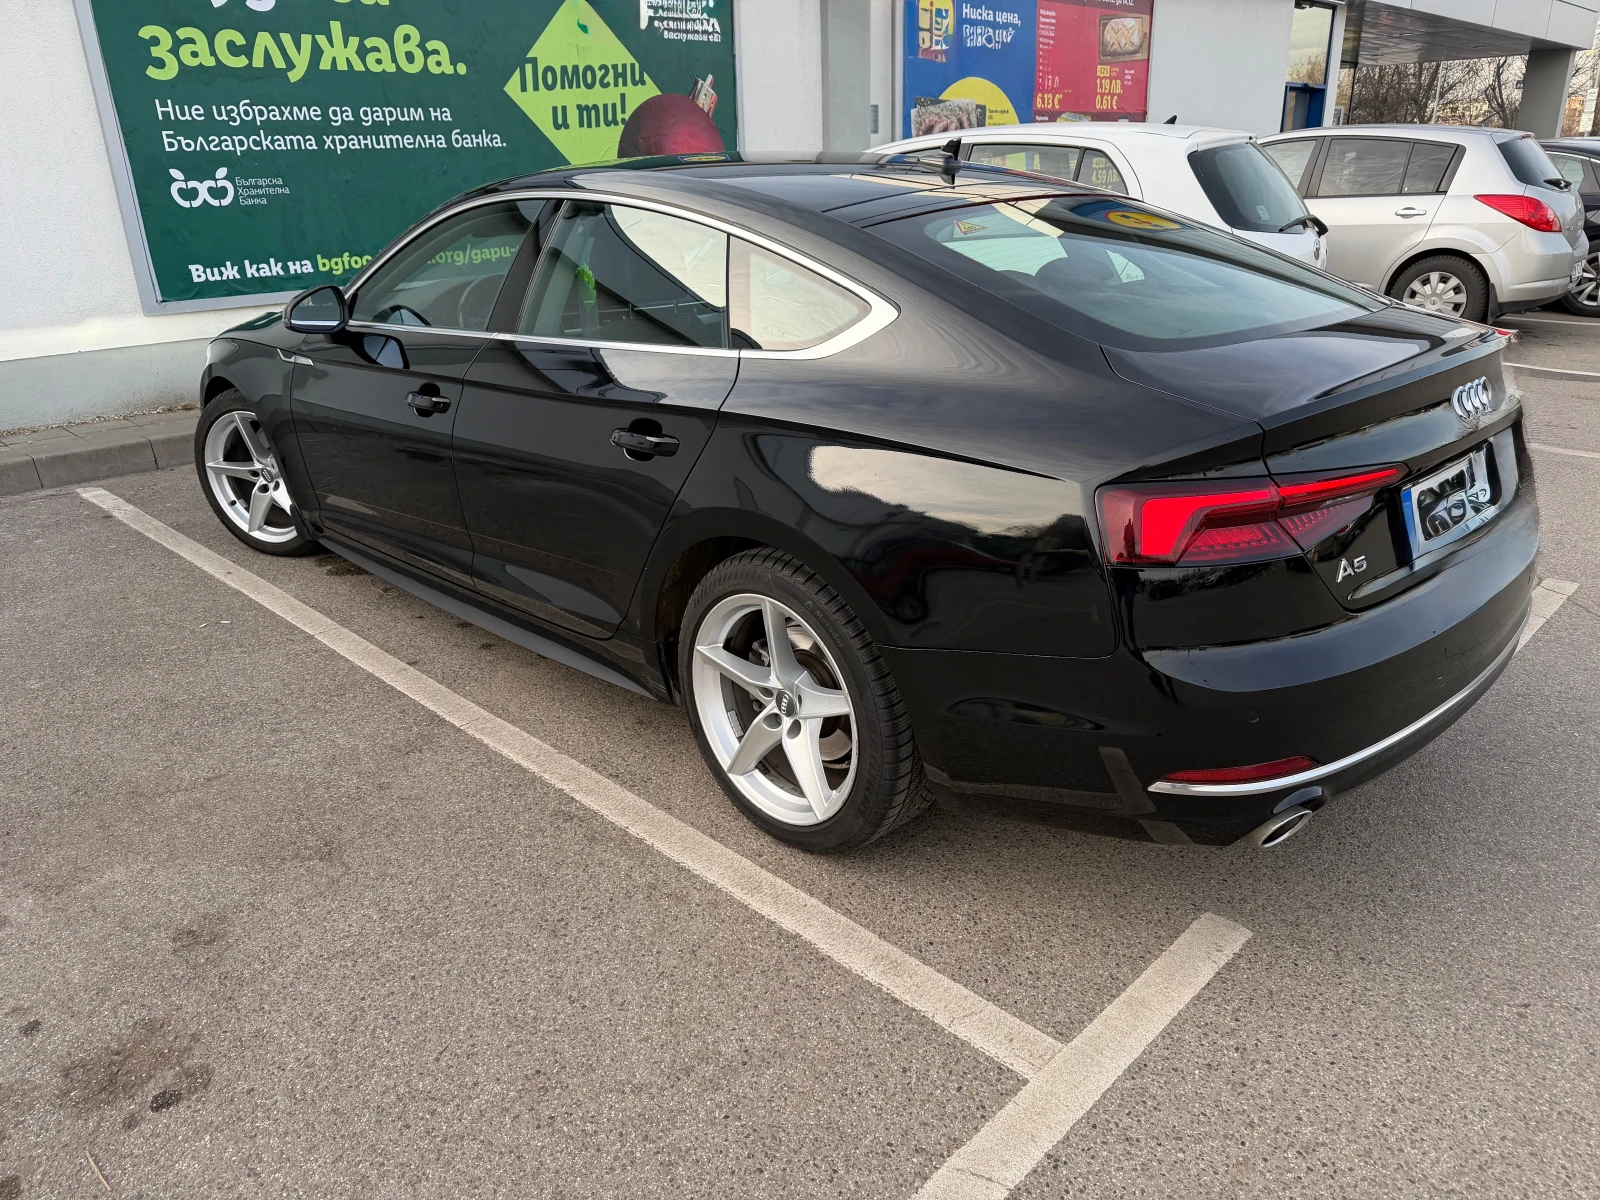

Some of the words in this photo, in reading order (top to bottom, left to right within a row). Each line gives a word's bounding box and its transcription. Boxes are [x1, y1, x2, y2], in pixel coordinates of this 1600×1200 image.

[962, 2, 994, 22] Ниска
[995, 10, 1022, 27] цена,
[518, 56, 647, 93] Помогни
[1096, 78, 1110, 94] 1.19
[154, 98, 205, 122] Ние
[212, 99, 322, 126] избрахме
[328, 105, 354, 126] да
[359, 104, 425, 126] дарим
[428, 107, 453, 122] на
[551, 104, 570, 131] и
[576, 92, 627, 129] ти!
[1036, 92, 1053, 109] 6.13
[1095, 94, 1111, 110] 0.61
[1112, 95, 1118, 110] €
[161, 129, 318, 156] Българската
[322, 131, 447, 155] хранителна
[451, 128, 508, 149] банка.
[235, 176, 284, 187] Българска
[237, 186, 290, 196] Хранителна
[239, 196, 268, 206] Банка
[188, 263, 241, 283] Виж
[244, 257, 285, 278] как
[288, 261, 314, 274] на
[316, 251, 373, 275] bgfoo
[1335, 555, 1367, 583] A5
